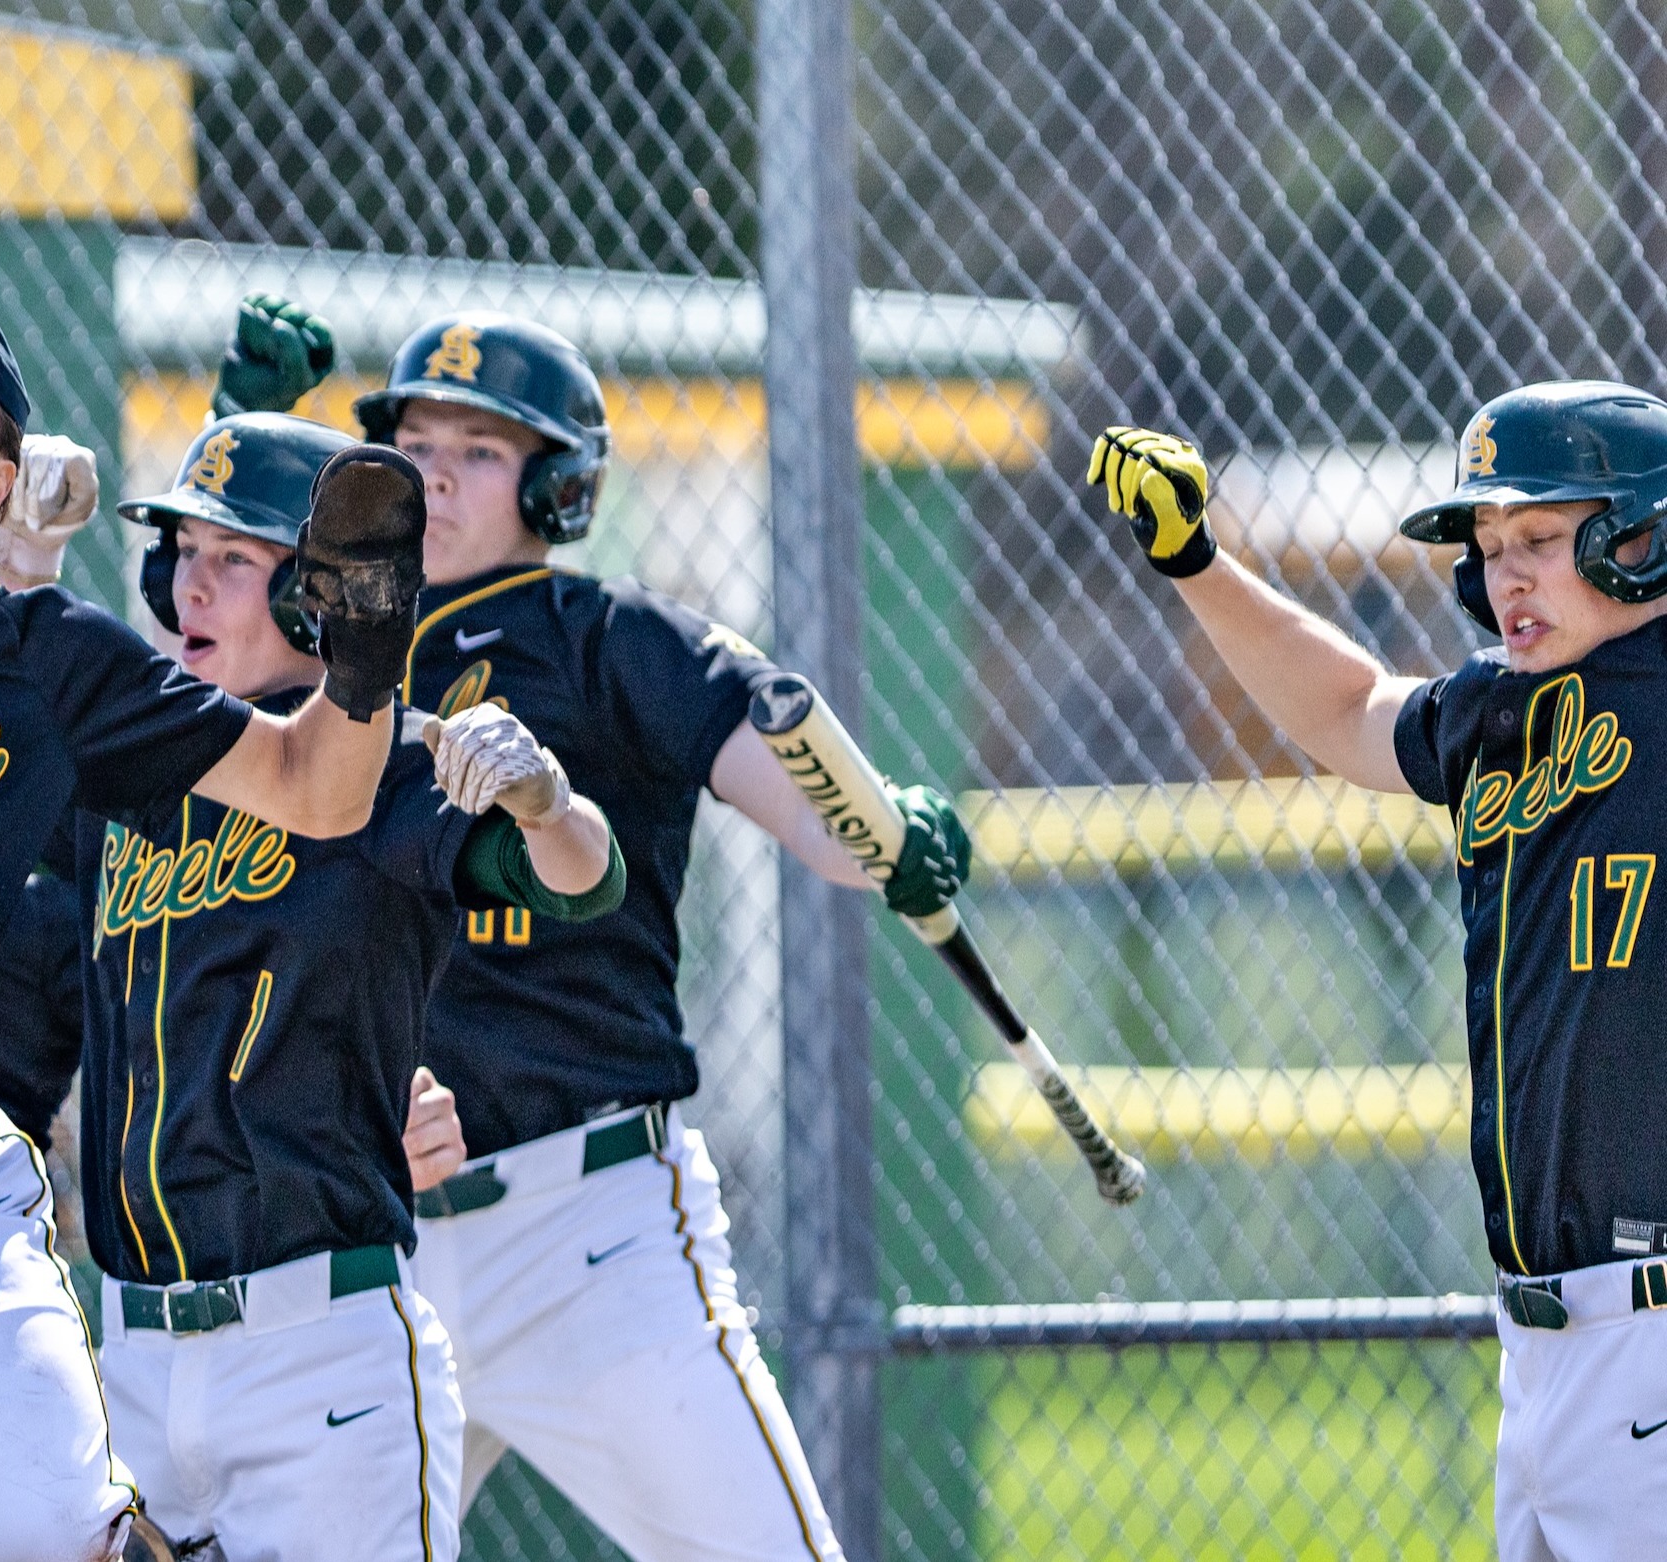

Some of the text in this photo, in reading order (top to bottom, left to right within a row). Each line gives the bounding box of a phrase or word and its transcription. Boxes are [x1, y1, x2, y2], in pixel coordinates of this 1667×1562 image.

[772, 737, 897, 882] OUISVILLE
[1569, 853, 1657, 972] 17
[228, 969, 274, 1083] 1
